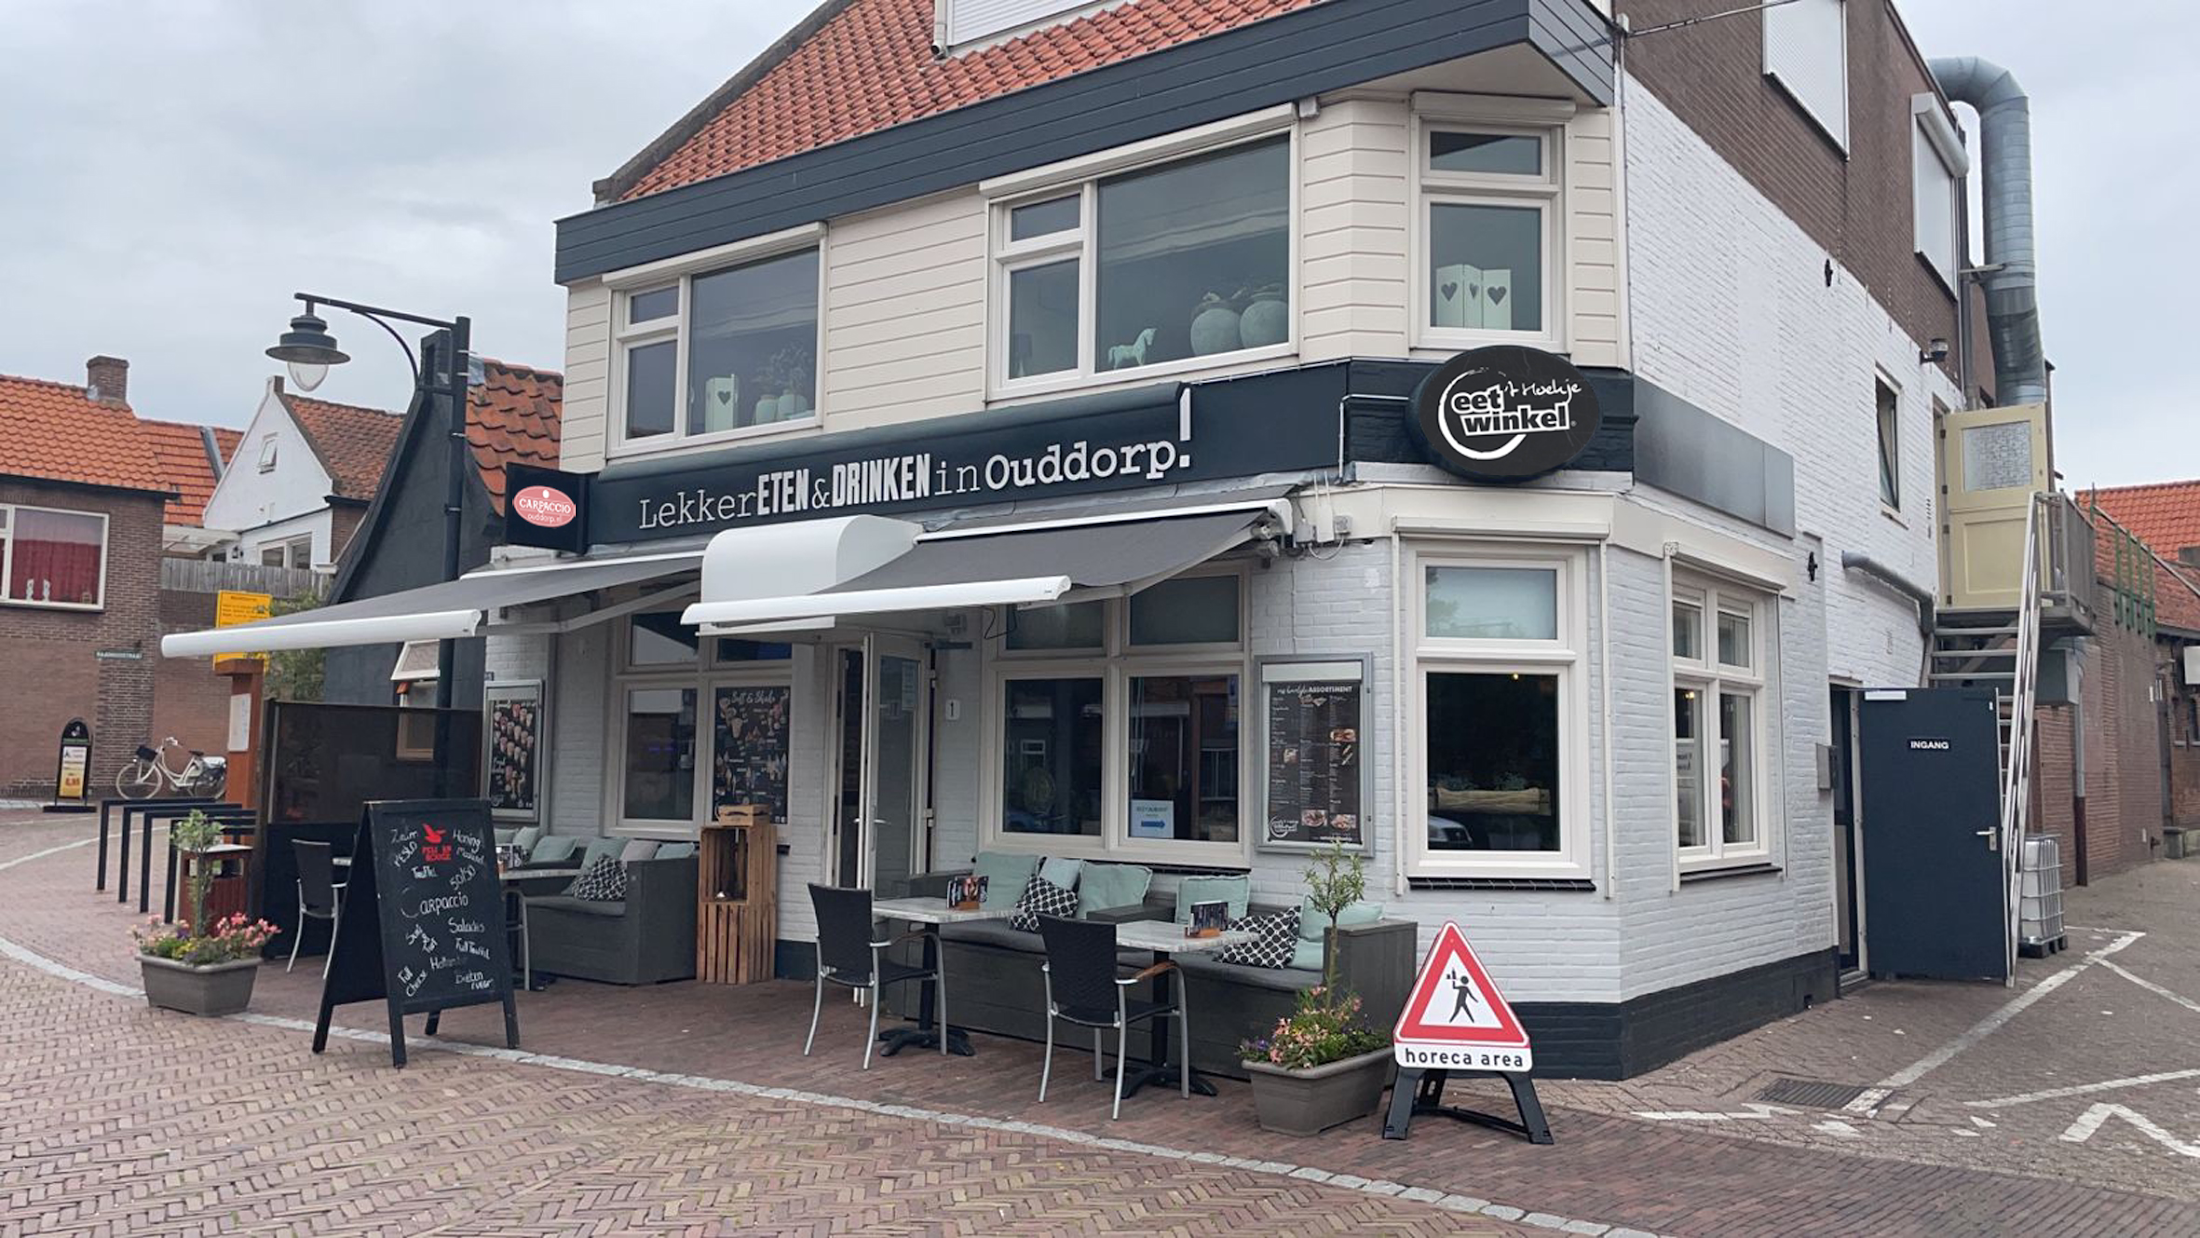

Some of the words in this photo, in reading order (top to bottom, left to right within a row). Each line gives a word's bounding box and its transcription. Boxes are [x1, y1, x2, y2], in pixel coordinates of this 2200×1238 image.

[1451, 384, 1504, 413] eet
[1460, 401, 1570, 436] winkel
[639, 489, 757, 529] Lekker
[757, 468, 810, 516] ETEN
[811, 478, 831, 509] &
[832, 453, 931, 507] DRINKEN
[934, 460, 981, 496] in
[984, 387, 1192, 491] Ouddorp!
[518, 498, 572, 514] CARPACCIO
[1910, 740, 1950, 749] INGANG
[1405, 1047, 1472, 1065] horeca
[1480, 1052, 1524, 1067] area
